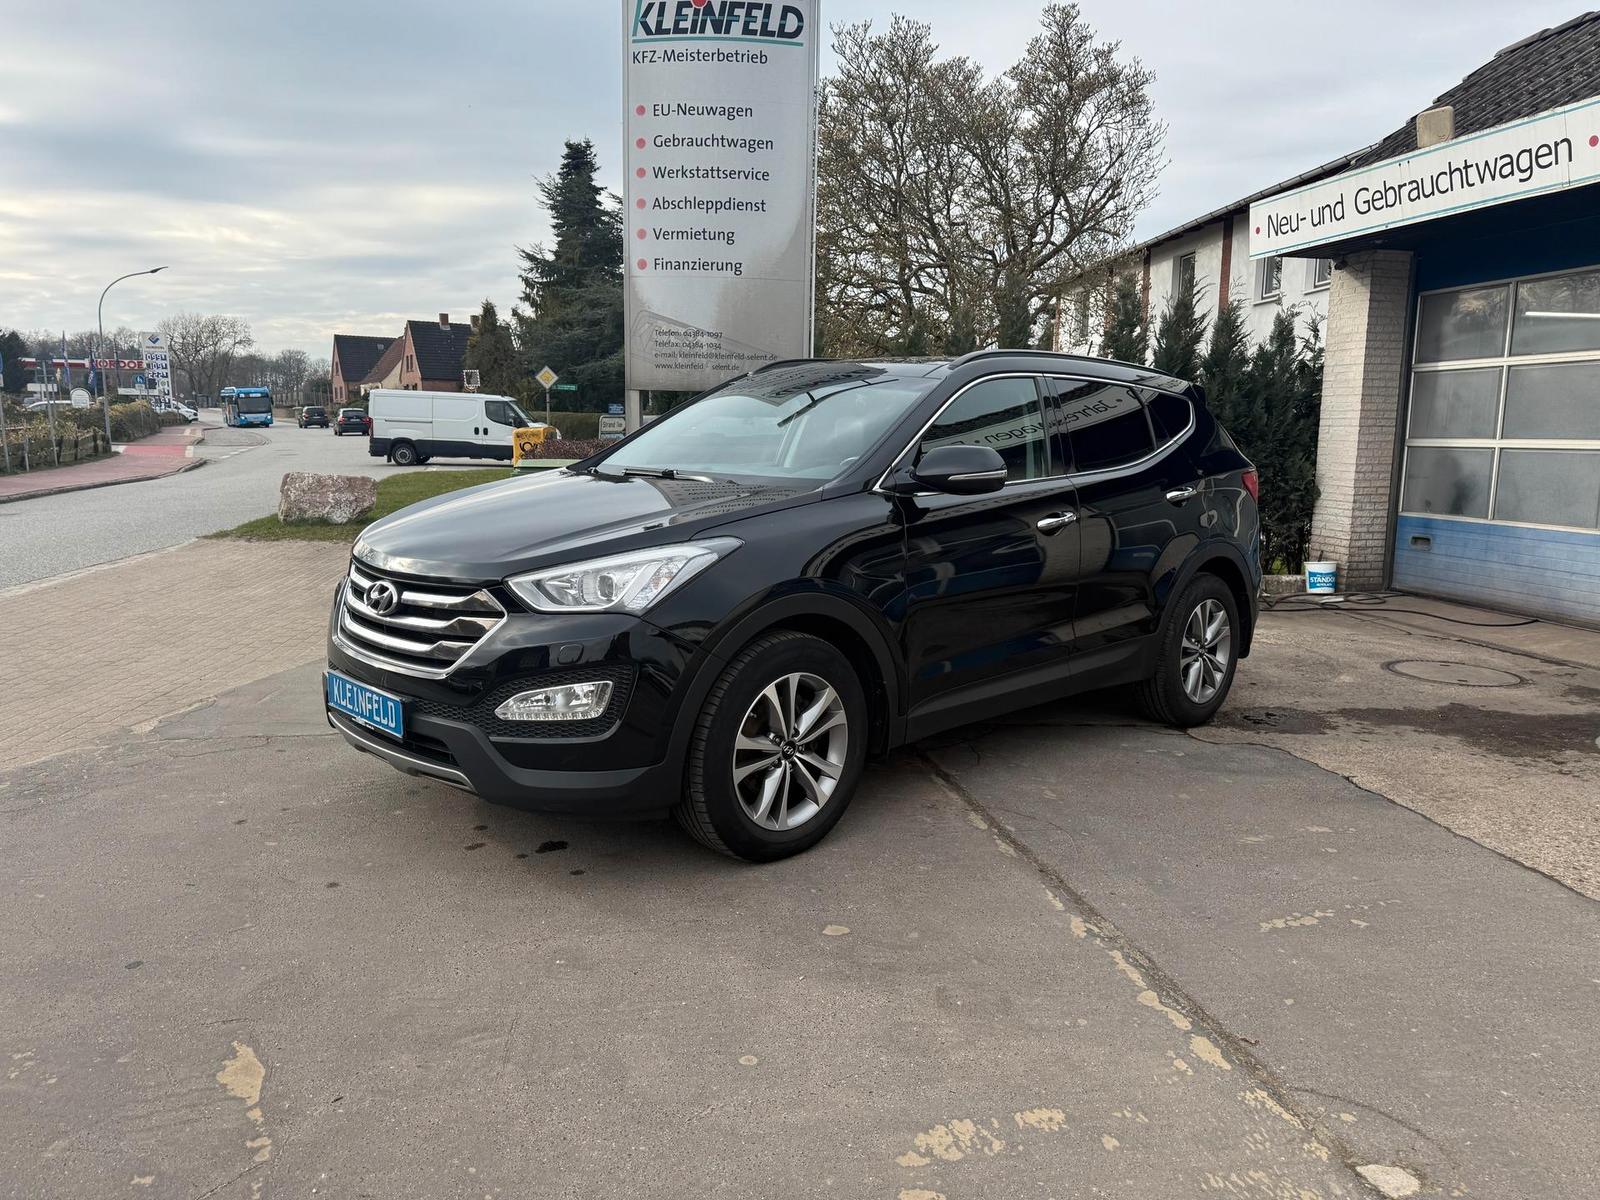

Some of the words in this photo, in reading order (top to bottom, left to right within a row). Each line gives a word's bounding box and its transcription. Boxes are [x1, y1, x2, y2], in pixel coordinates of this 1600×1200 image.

[632, 49, 768, 64] KFZ-Meisterbetrieb
[653, 103, 753, 120] EU-Neuwagen
[653, 134, 774, 153] Gebrauchtwagen
[653, 165, 770, 181] Werkstattservice
[1354, 137, 1574, 216] Gebrauchtwagen
[652, 197, 767, 214] Abschleppdienst
[653, 227, 735, 245] Vermietung
[654, 257, 743, 276] Finanzierung
[333, 679, 396, 727] KLEINFELD
